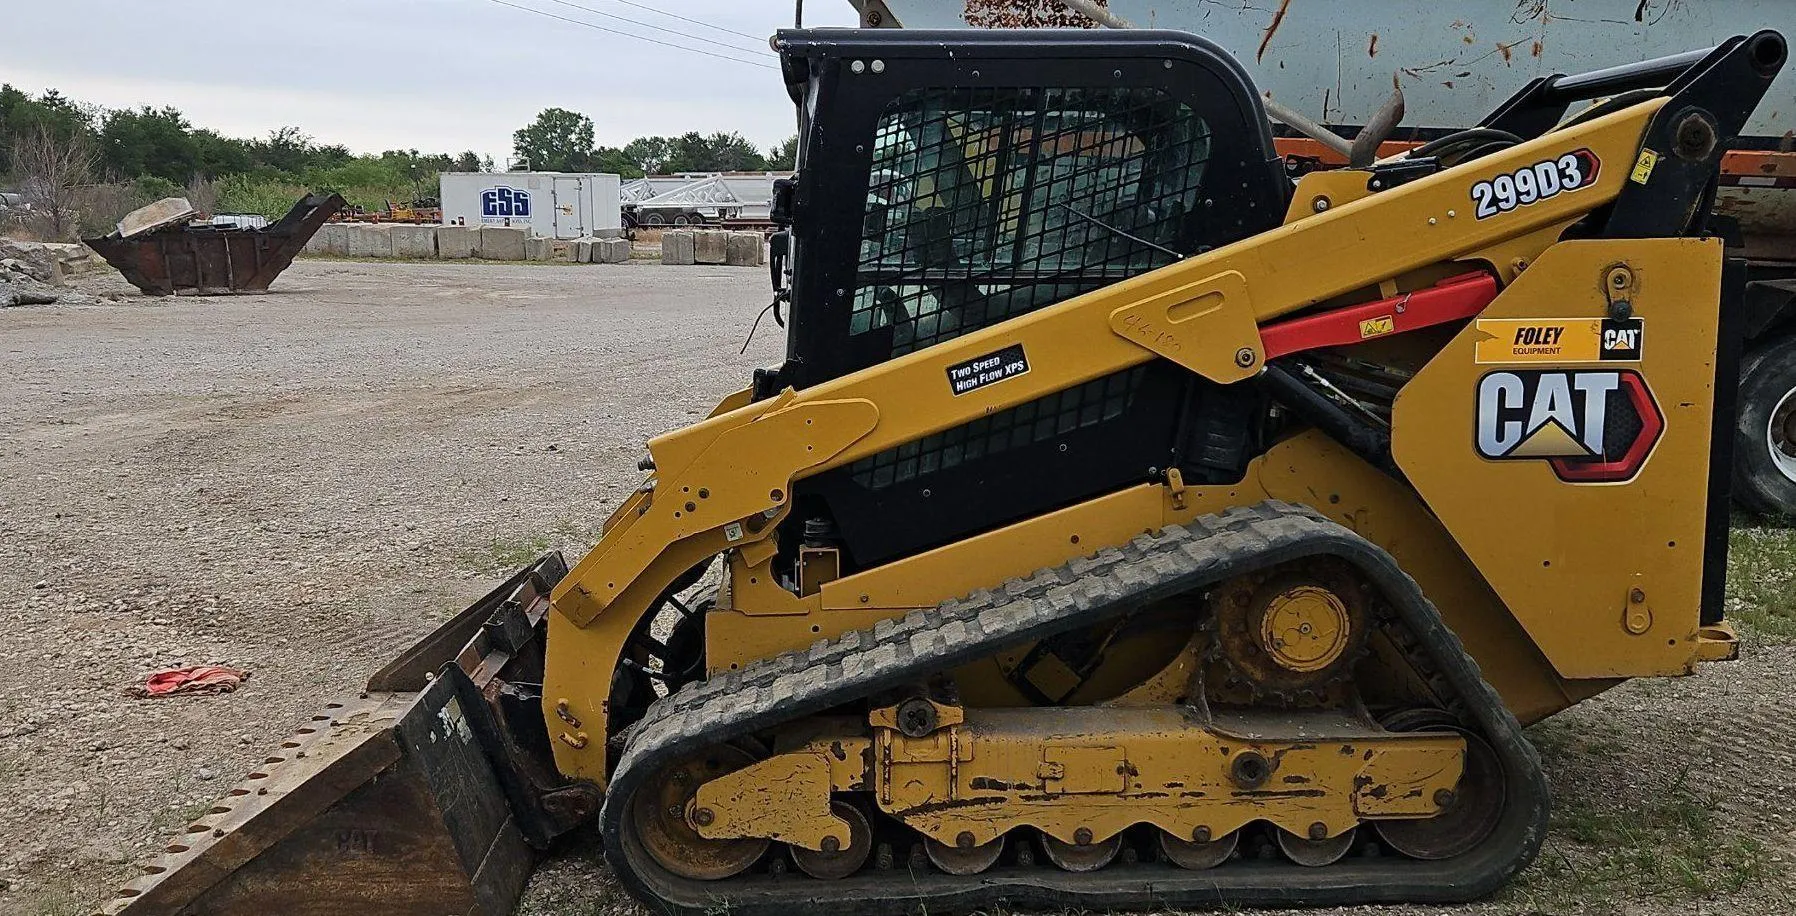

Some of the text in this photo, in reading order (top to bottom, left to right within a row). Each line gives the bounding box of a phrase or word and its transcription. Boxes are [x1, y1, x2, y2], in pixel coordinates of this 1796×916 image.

[1472, 154, 1582, 218] 299D3
[482, 188, 530, 216] ESS
[1513, 327, 1638, 350] FOLEY CAT
[1513, 347, 1562, 355] EQUIPMENT
[1005, 360, 1024, 376] XPS
[1478, 372, 1620, 457] CAT
